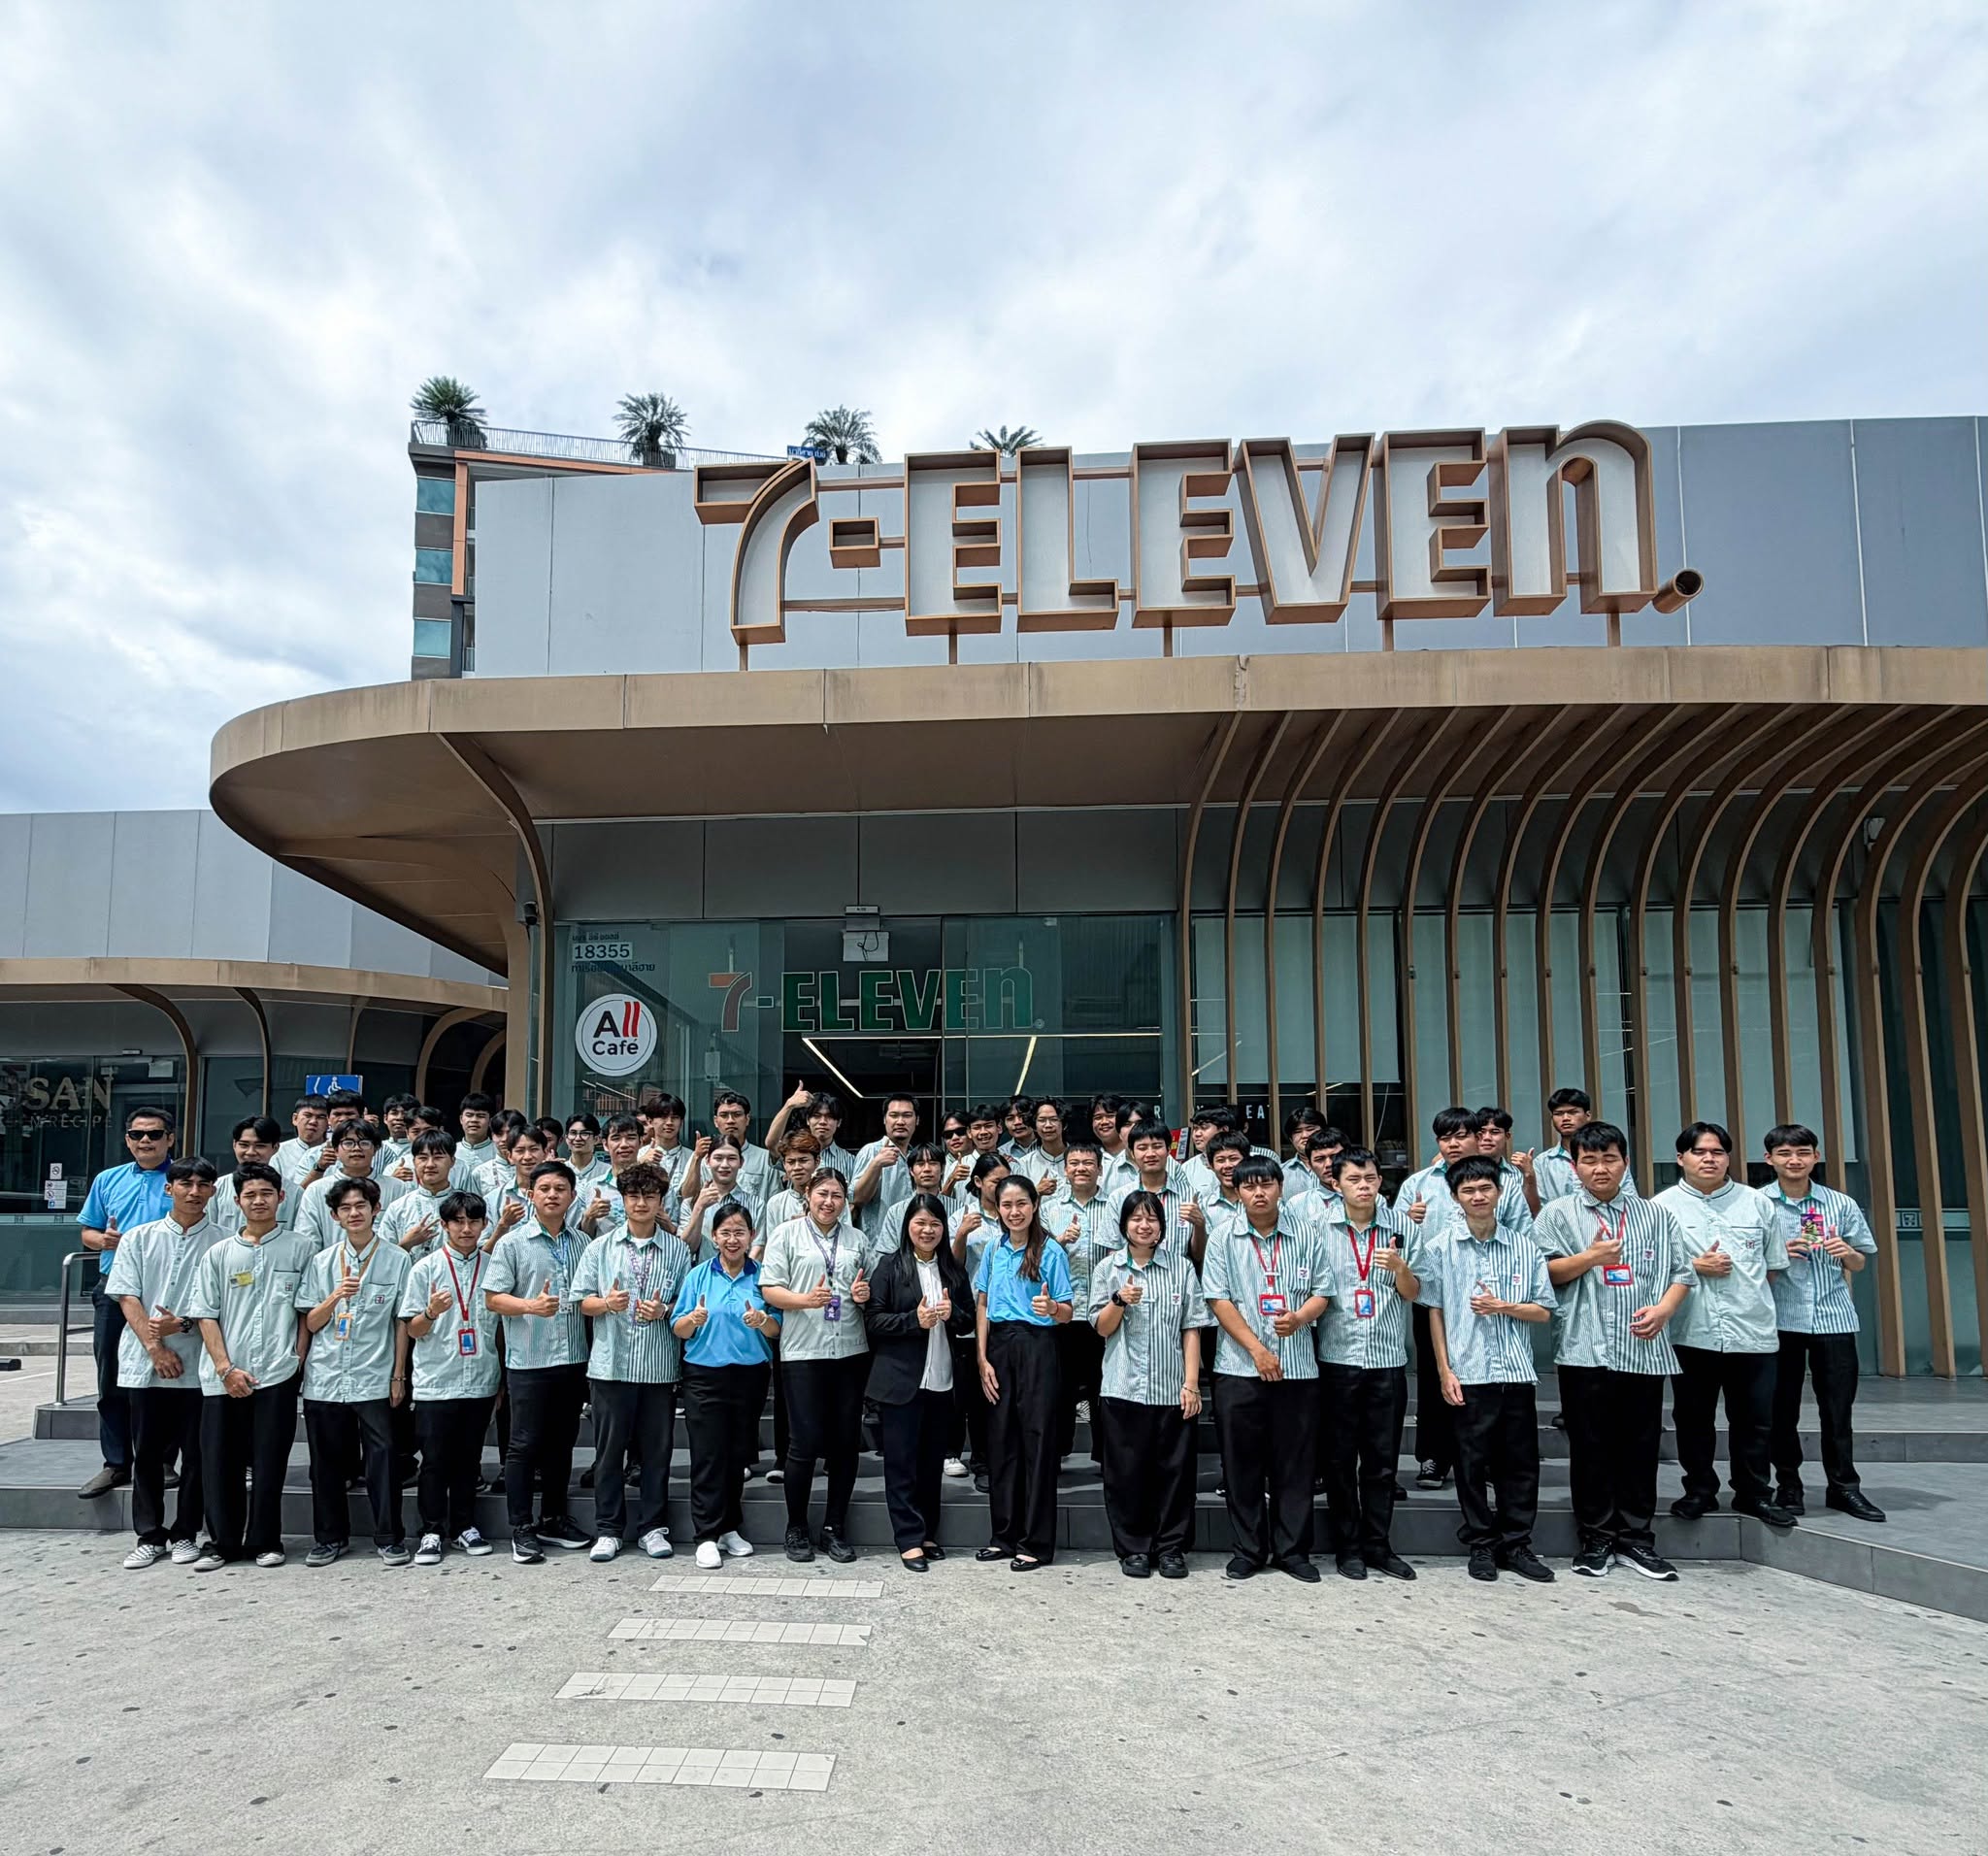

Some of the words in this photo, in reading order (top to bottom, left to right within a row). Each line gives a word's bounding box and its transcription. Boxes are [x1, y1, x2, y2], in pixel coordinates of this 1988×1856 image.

[575, 944, 630, 959] 18355
[593, 1001, 641, 1038] All
[592, 1039, 639, 1055] Café
[1245, 1105, 1271, 1119] EA
